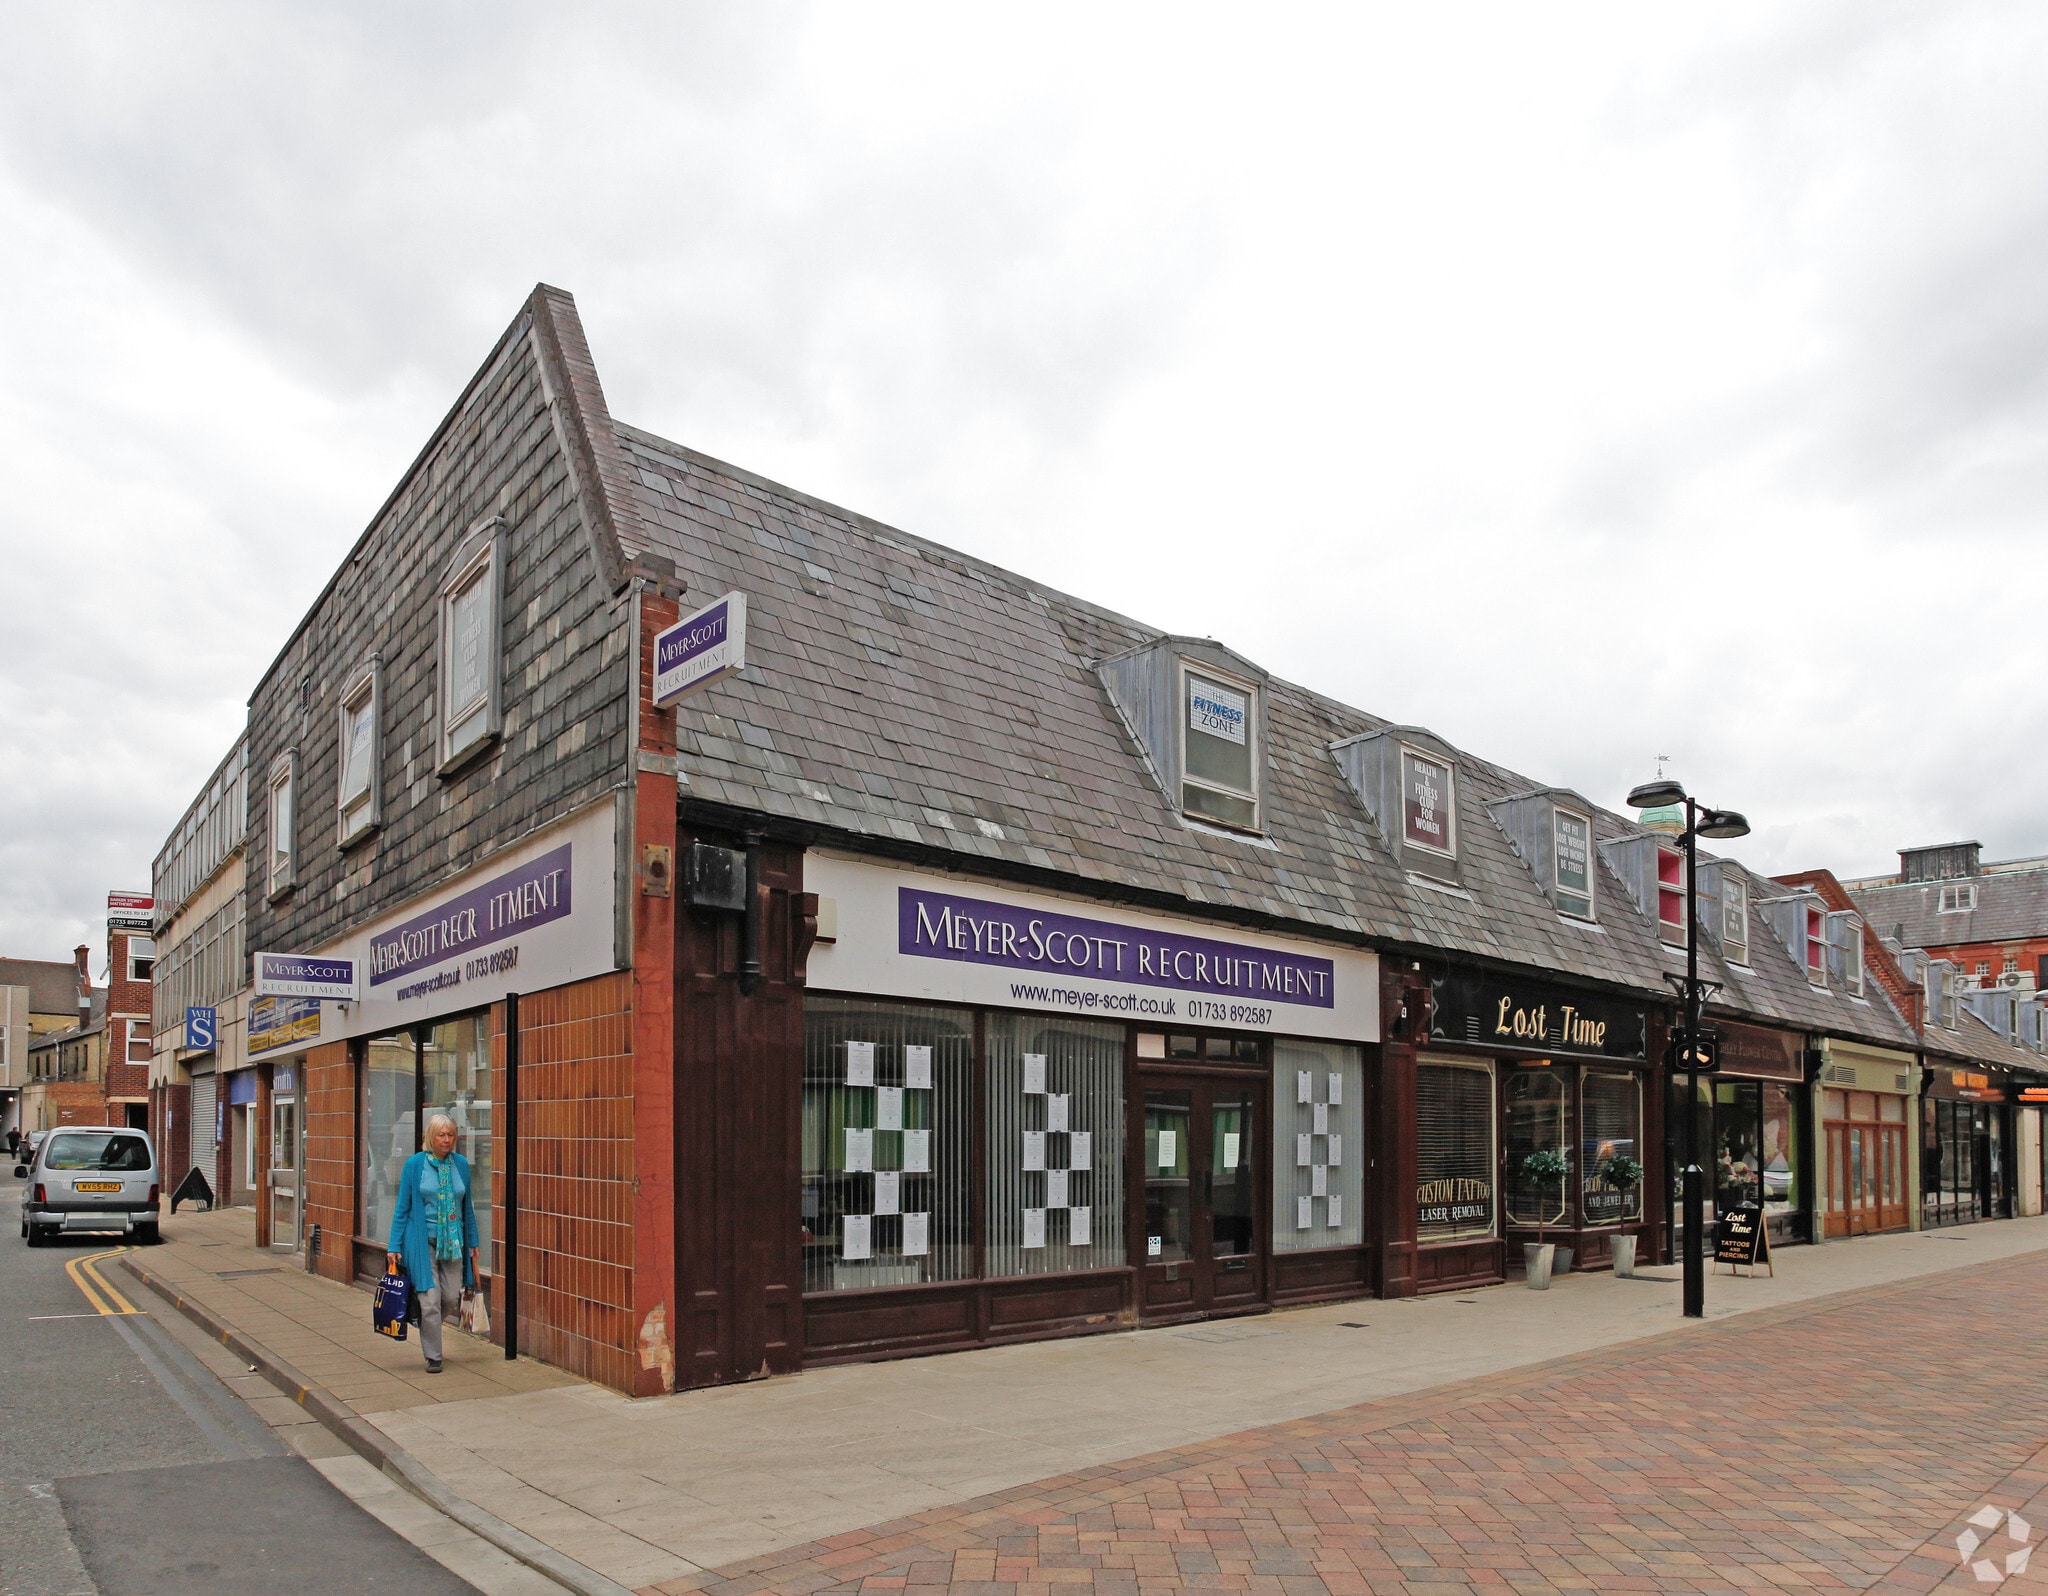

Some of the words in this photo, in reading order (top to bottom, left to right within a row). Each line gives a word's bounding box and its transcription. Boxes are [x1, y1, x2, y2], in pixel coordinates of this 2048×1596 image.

[660, 616, 725, 665] MEYER-SCOTT
[657, 648, 726, 693] RECRUITMENT
[1212, 692, 1225, 702] THE
[1193, 696, 1243, 725] FITNESS
[1202, 712, 1236, 735] ZONE
[1414, 760, 1437, 779] HEALTH
[1415, 782, 1438, 801] FITNESS
[1425, 777, 1430, 788] &
[1419, 796, 1435, 810] CLUB
[1421, 808, 1433, 823] FOR
[1415, 817, 1440, 836] WOMEN
[1556, 832, 1567, 845] LOSE
[1568, 836, 1585, 850] WEIGHT
[1558, 845, 1569, 858] LOSE
[1568, 861, 1583, 875] STRESS
[915, 901, 1128, 973] MEYER-SCOTT
[1139, 944, 1329, 998] RECRUITMENT
[265, 962, 350, 979] MEYER-SCOTT
[466, 957, 489, 980] 01733
[489, 946, 519, 975] 892587
[262, 983, 352, 995] RECRUITMENT
[1010, 983, 1176, 1016] www.meyer-scott.co.uk
[1188, 1002, 1227, 1022] 01733
[1230, 1005, 1273, 1025] 892587
[191, 1009, 211, 1019] WH
[1495, 996, 1547, 1040] Lost
[1560, 1005, 1606, 1048] Time
[191, 1018, 213, 1047] S
[1417, 1178, 1453, 1203] CUSTOM
[1455, 1177, 1490, 1201] TATTOO
[1421, 1207, 1448, 1222] LASER
[1452, 1204, 1485, 1221] REMOVAL
[1725, 1211, 1747, 1222] Lost
[1731, 1222, 1752, 1233] Time
